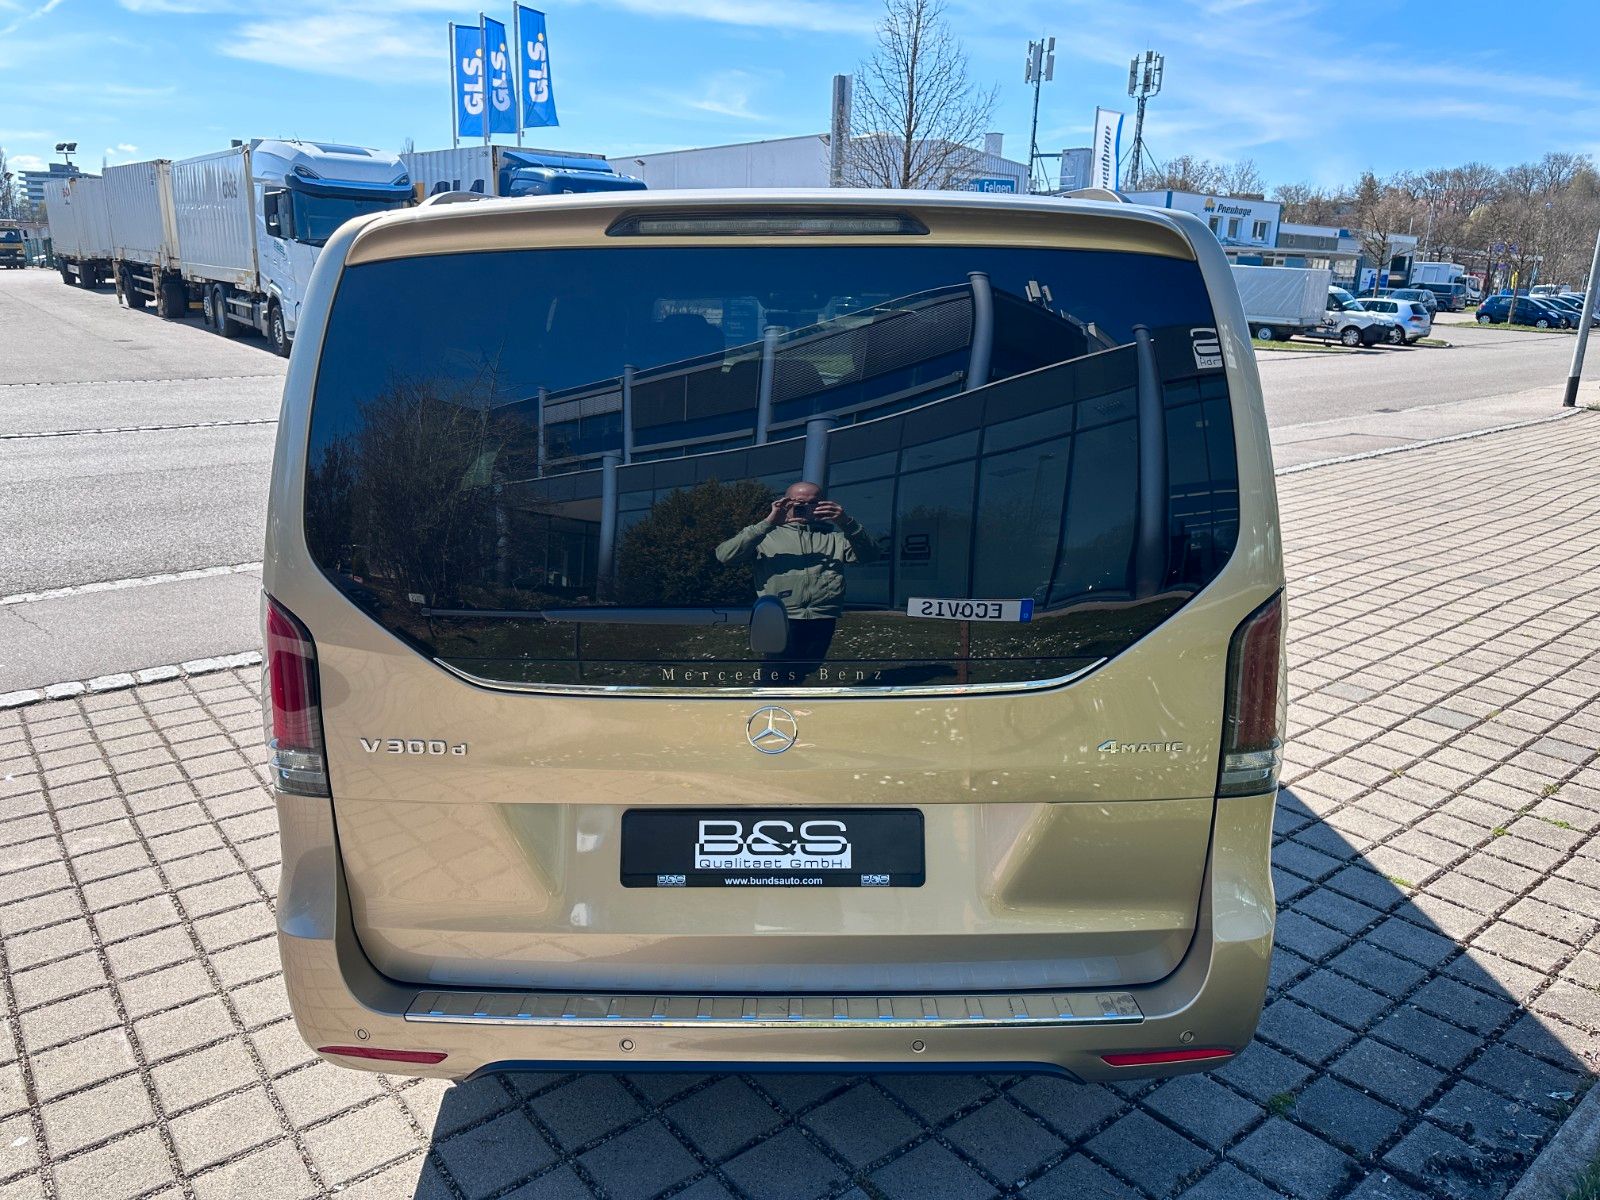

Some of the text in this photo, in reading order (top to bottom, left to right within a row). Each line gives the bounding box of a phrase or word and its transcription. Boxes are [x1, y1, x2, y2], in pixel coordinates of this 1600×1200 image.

[1217, 203, 1252, 217] Pneuhage
[1097, 739, 1184, 754] 4MATIC
[698, 820, 848, 856] B&S
[699, 857, 782, 868] Qualitaet
[724, 876, 823, 885] www.bundsauto.com
